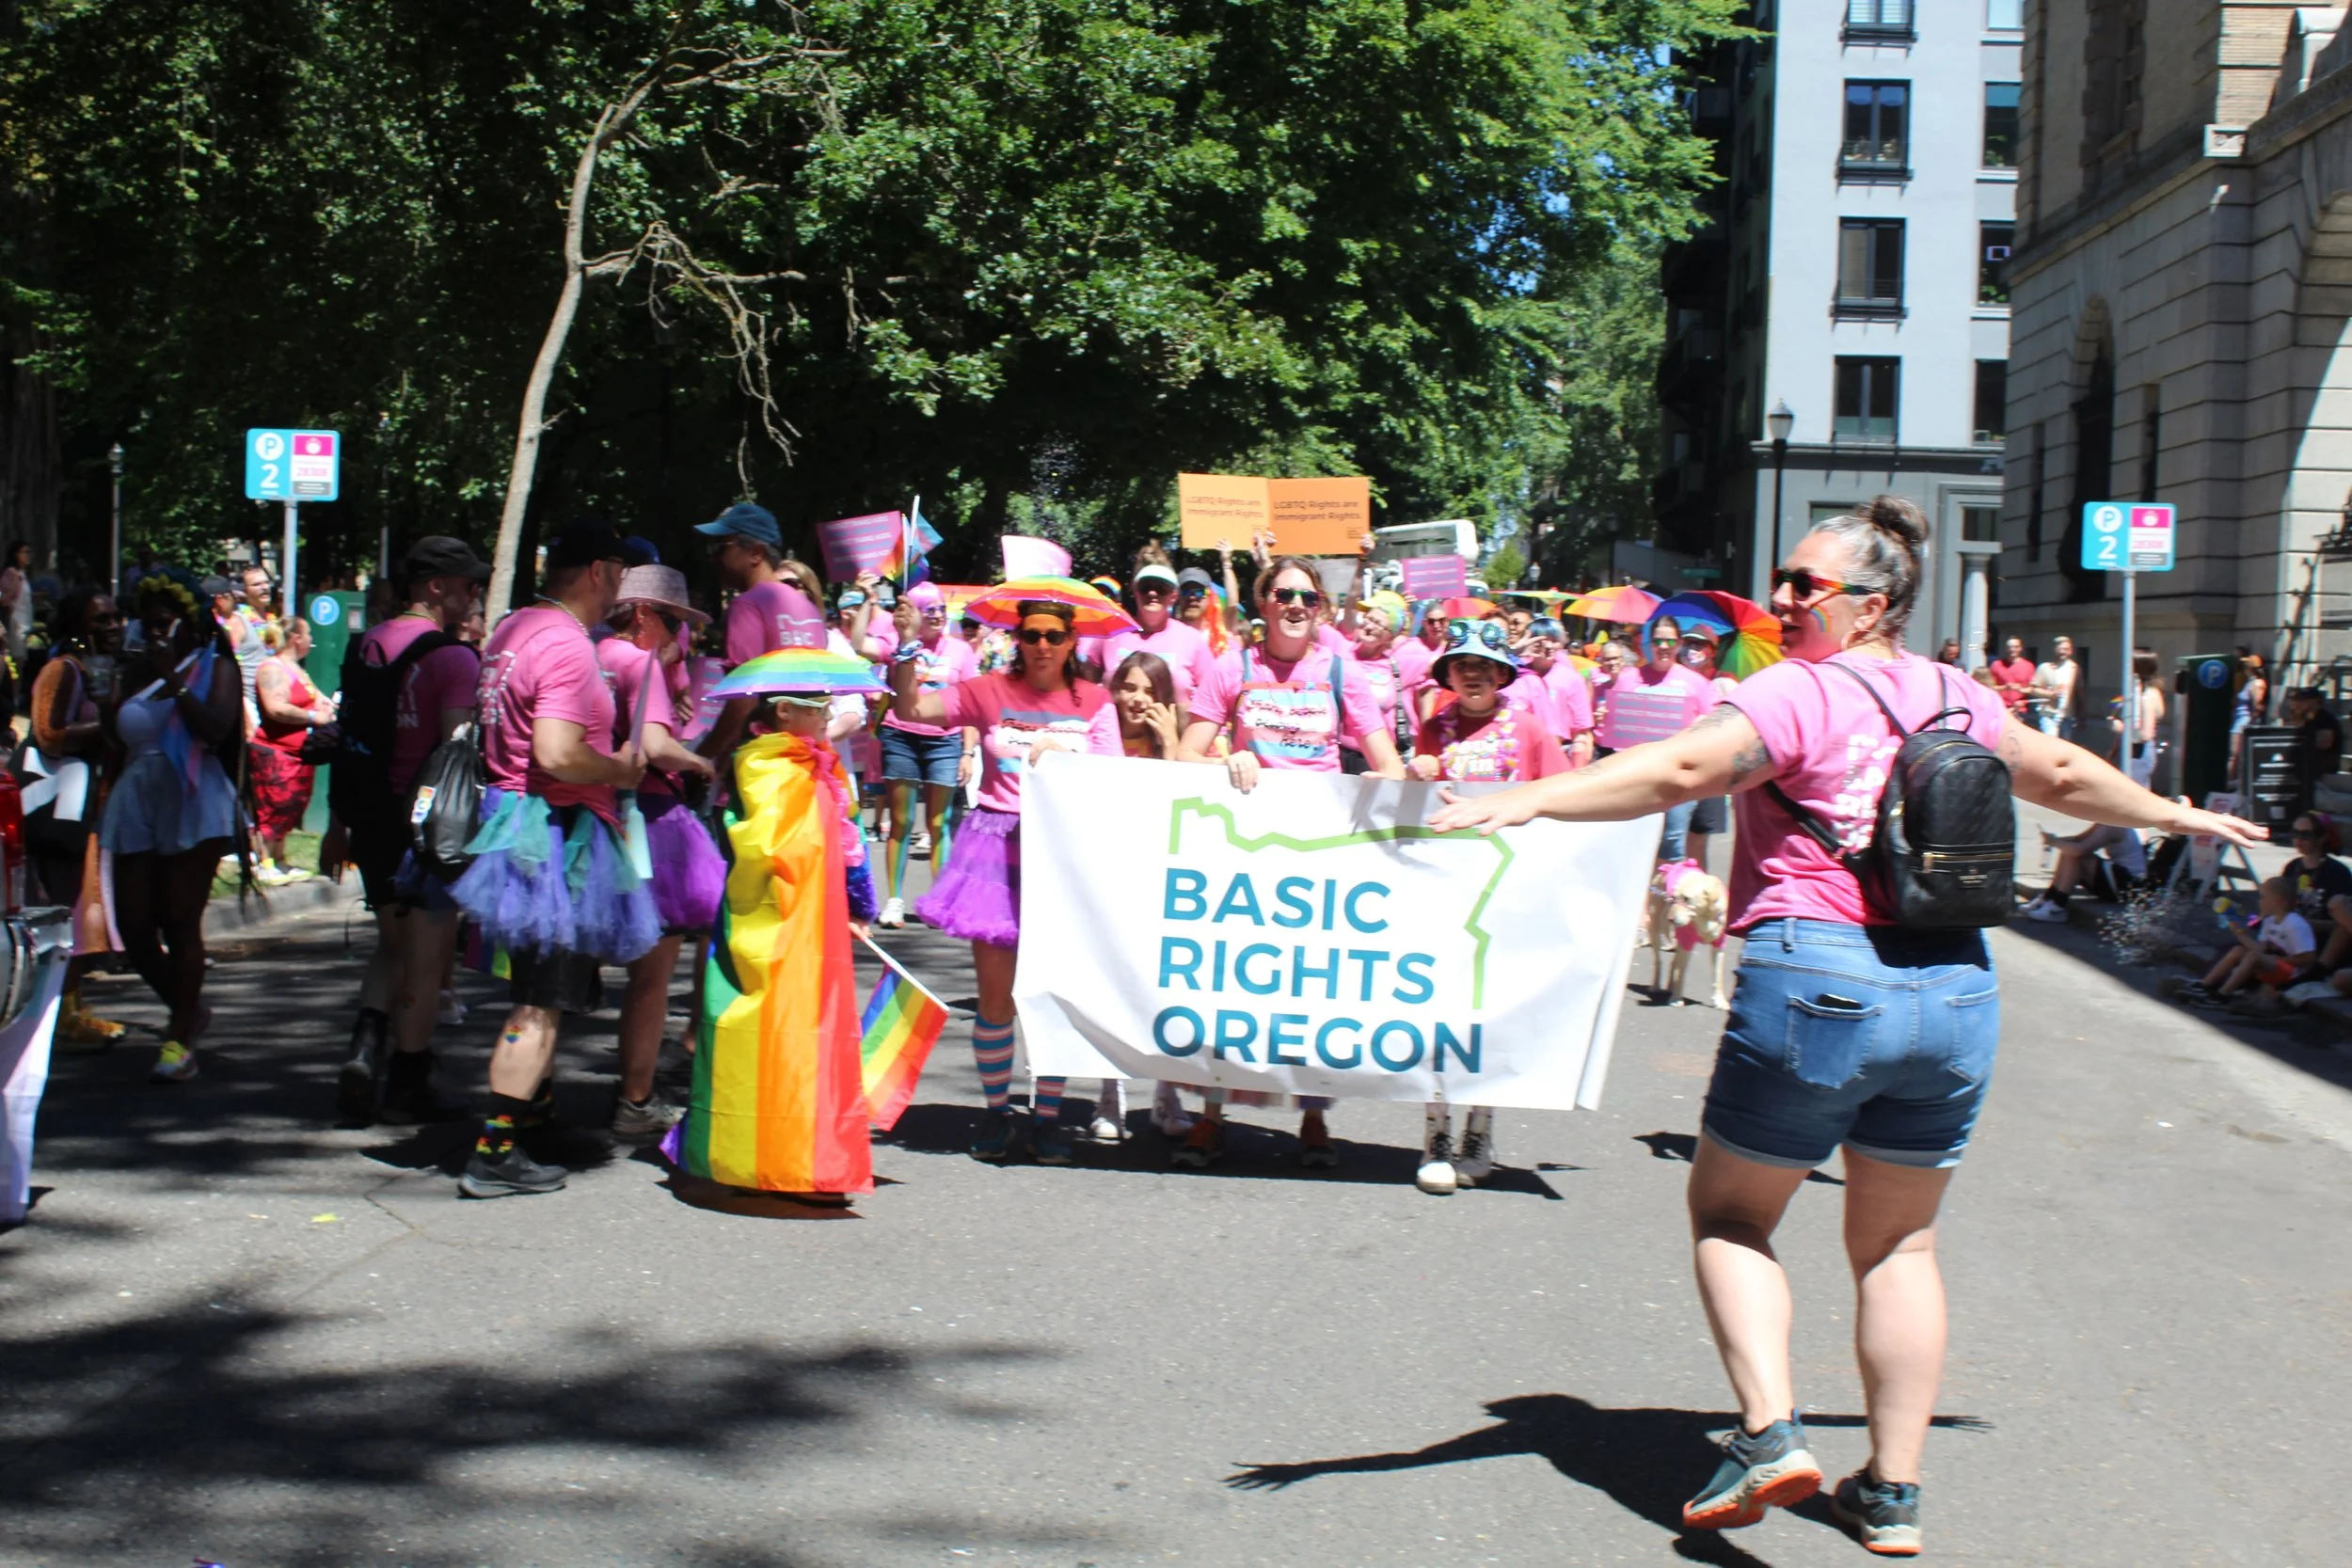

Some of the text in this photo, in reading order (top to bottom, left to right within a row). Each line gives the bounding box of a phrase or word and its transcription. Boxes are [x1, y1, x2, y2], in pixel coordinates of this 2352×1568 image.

[260, 464, 279, 488] 2
[1217, 497, 1245, 507] Rights
[1274, 499, 1306, 510] LGBTQ
[1309, 500, 1340, 511] Rights
[1186, 508, 1233, 518] Immigrant
[1274, 512, 1327, 522] Immigrant
[2098, 535, 2118, 560] 2
[318, 602, 332, 621] P
[2208, 665, 2222, 685] P
[1163, 867, 1391, 934] BASIC
[1158, 936, 1437, 1005] RIGHTS
[1152, 1006, 1482, 1074] OREGON
